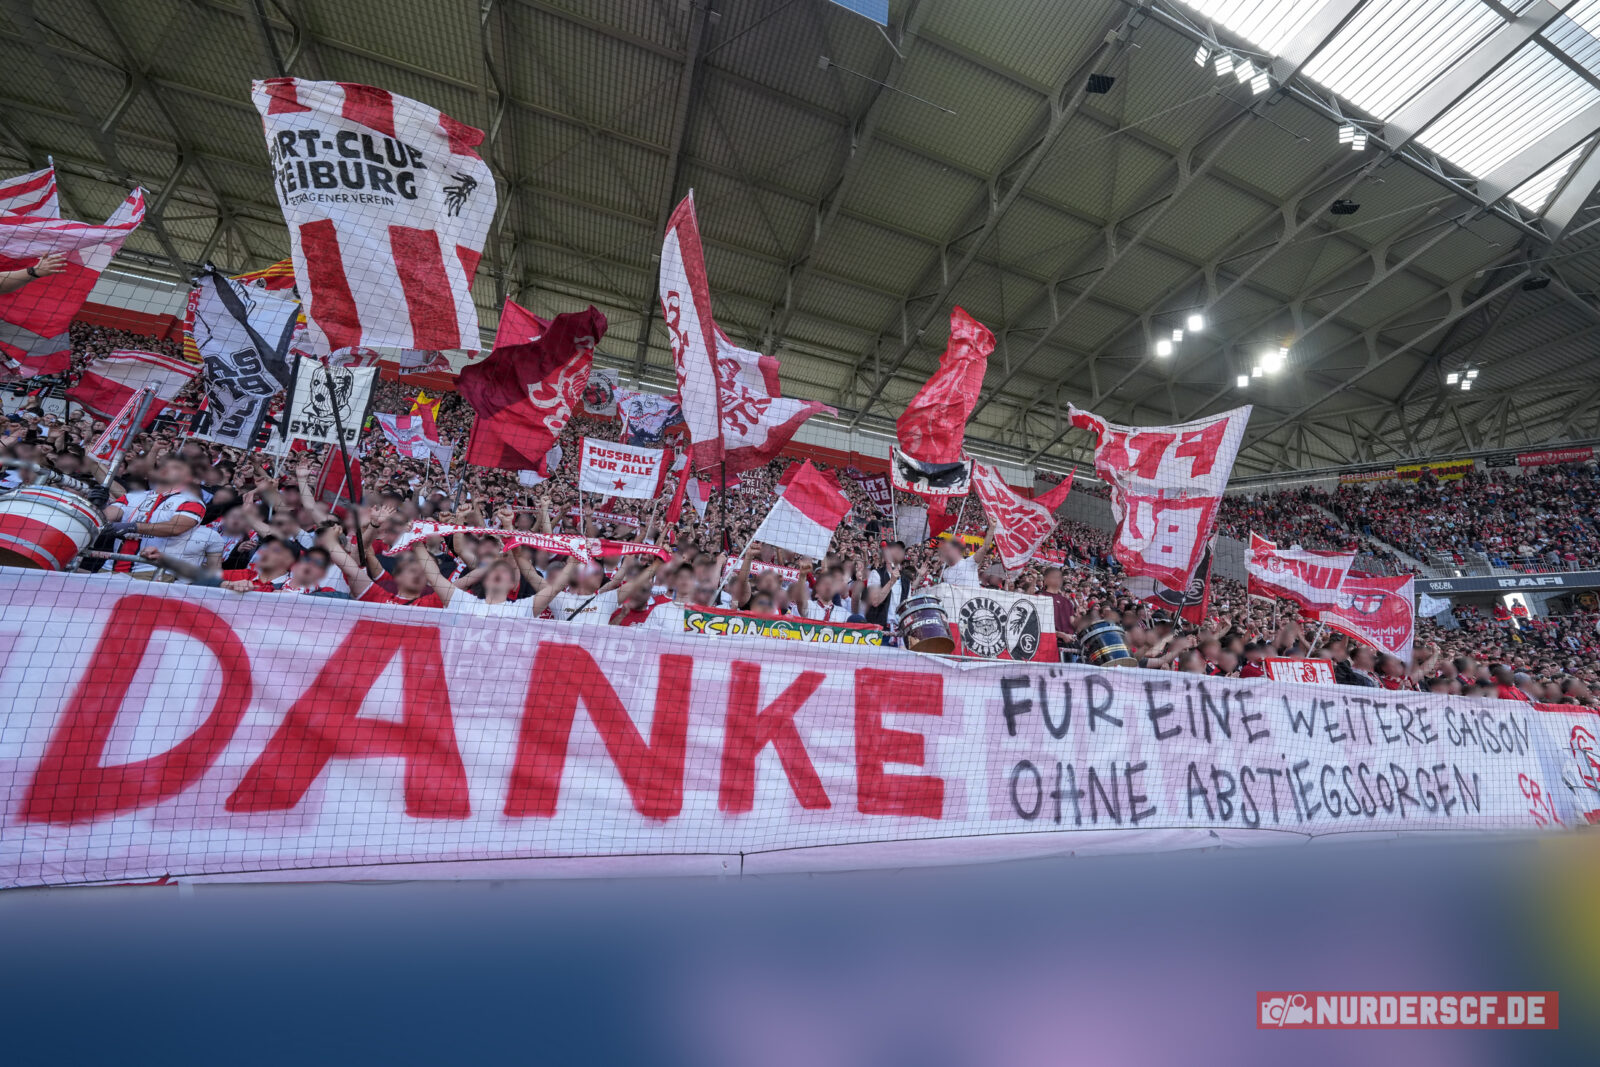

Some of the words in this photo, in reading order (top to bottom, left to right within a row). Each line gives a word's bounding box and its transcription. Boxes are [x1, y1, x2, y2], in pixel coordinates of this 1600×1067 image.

[350, 193, 395, 206] VEREIN
[588, 445, 656, 465] FUSSBALL
[589, 458, 618, 472] FÜR
[620, 464, 654, 476] ALLE
[1340, 469, 1396, 481] FREIBURG
[1497, 576, 1564, 588] RAFI
[15, 593, 944, 825] DANKE
[1001, 669, 1123, 739] FÜR
[1009, 760, 1157, 826] OHNE
